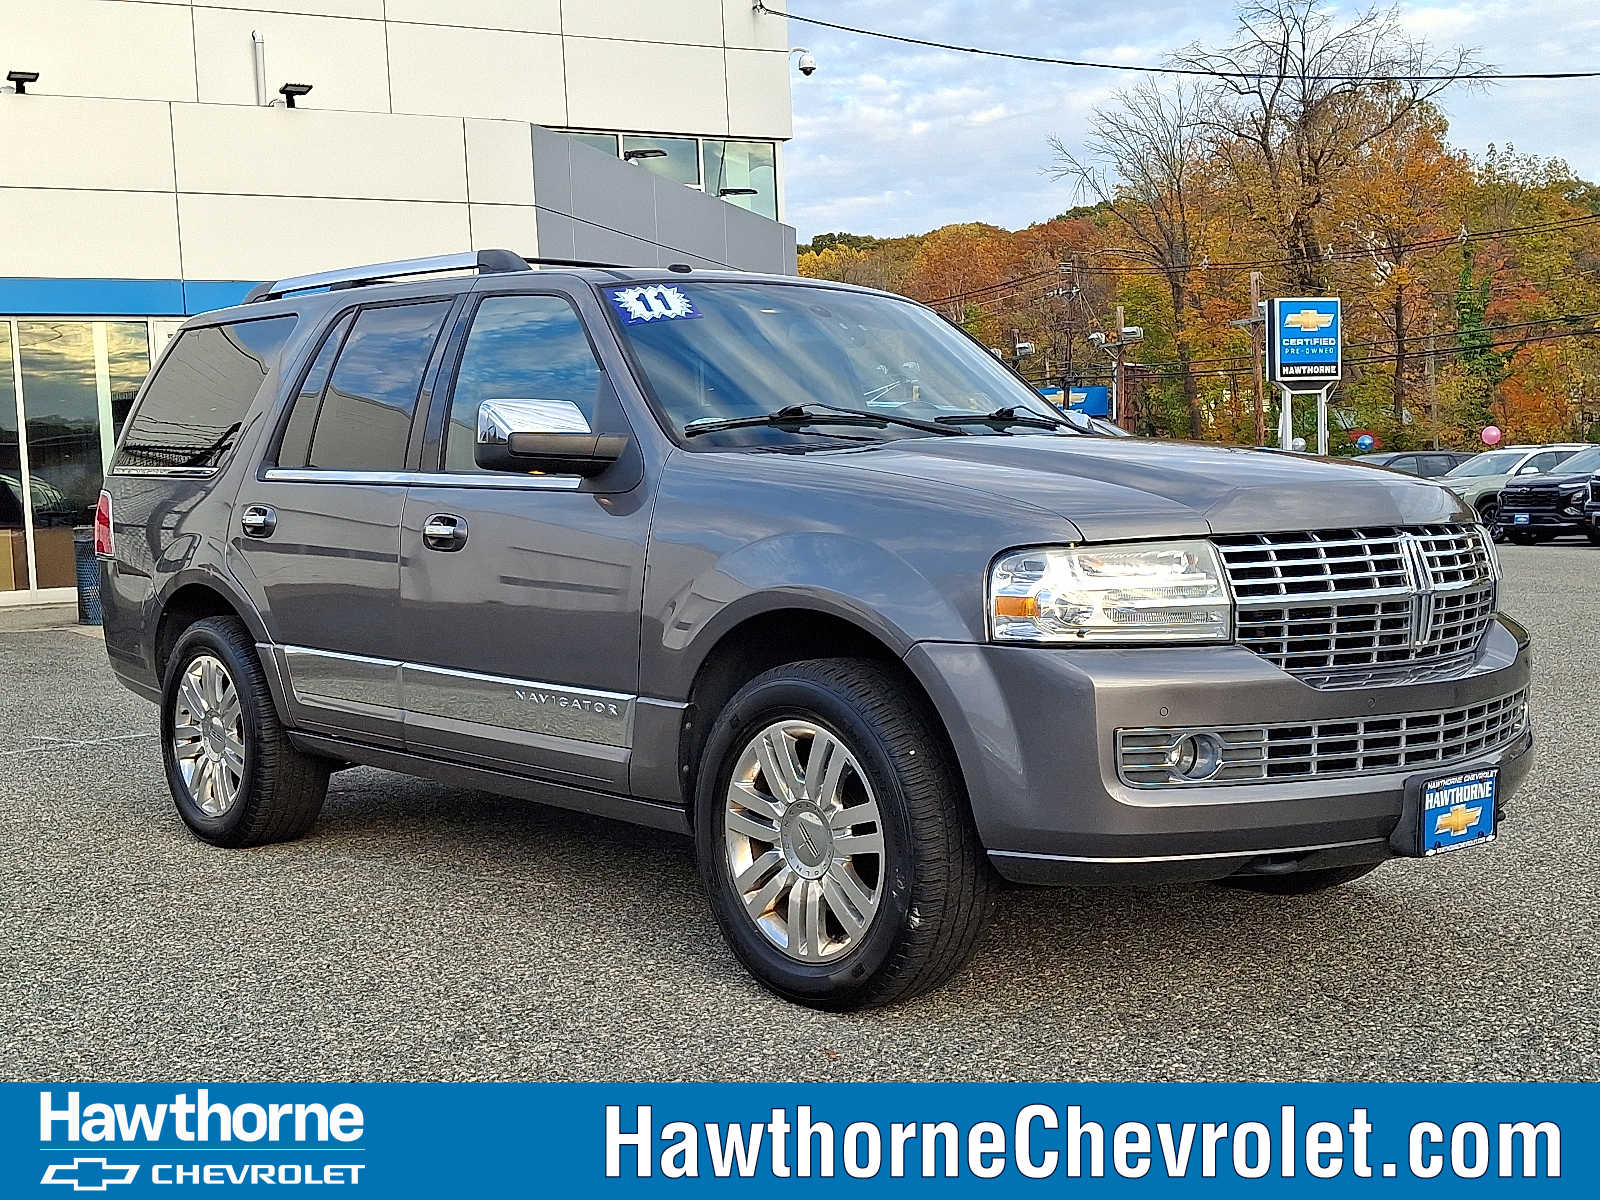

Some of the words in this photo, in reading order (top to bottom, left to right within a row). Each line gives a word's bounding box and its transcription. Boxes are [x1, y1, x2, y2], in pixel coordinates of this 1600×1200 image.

[635, 291, 673, 313] 11
[1282, 337, 1336, 346] CERTIFIED
[1284, 347, 1334, 355] PRE-OWNED
[1282, 365, 1337, 375] HAWTHORNE
[515, 689, 618, 717] NAVIGATOR
[1424, 780, 1493, 811] HAWTHORNE
